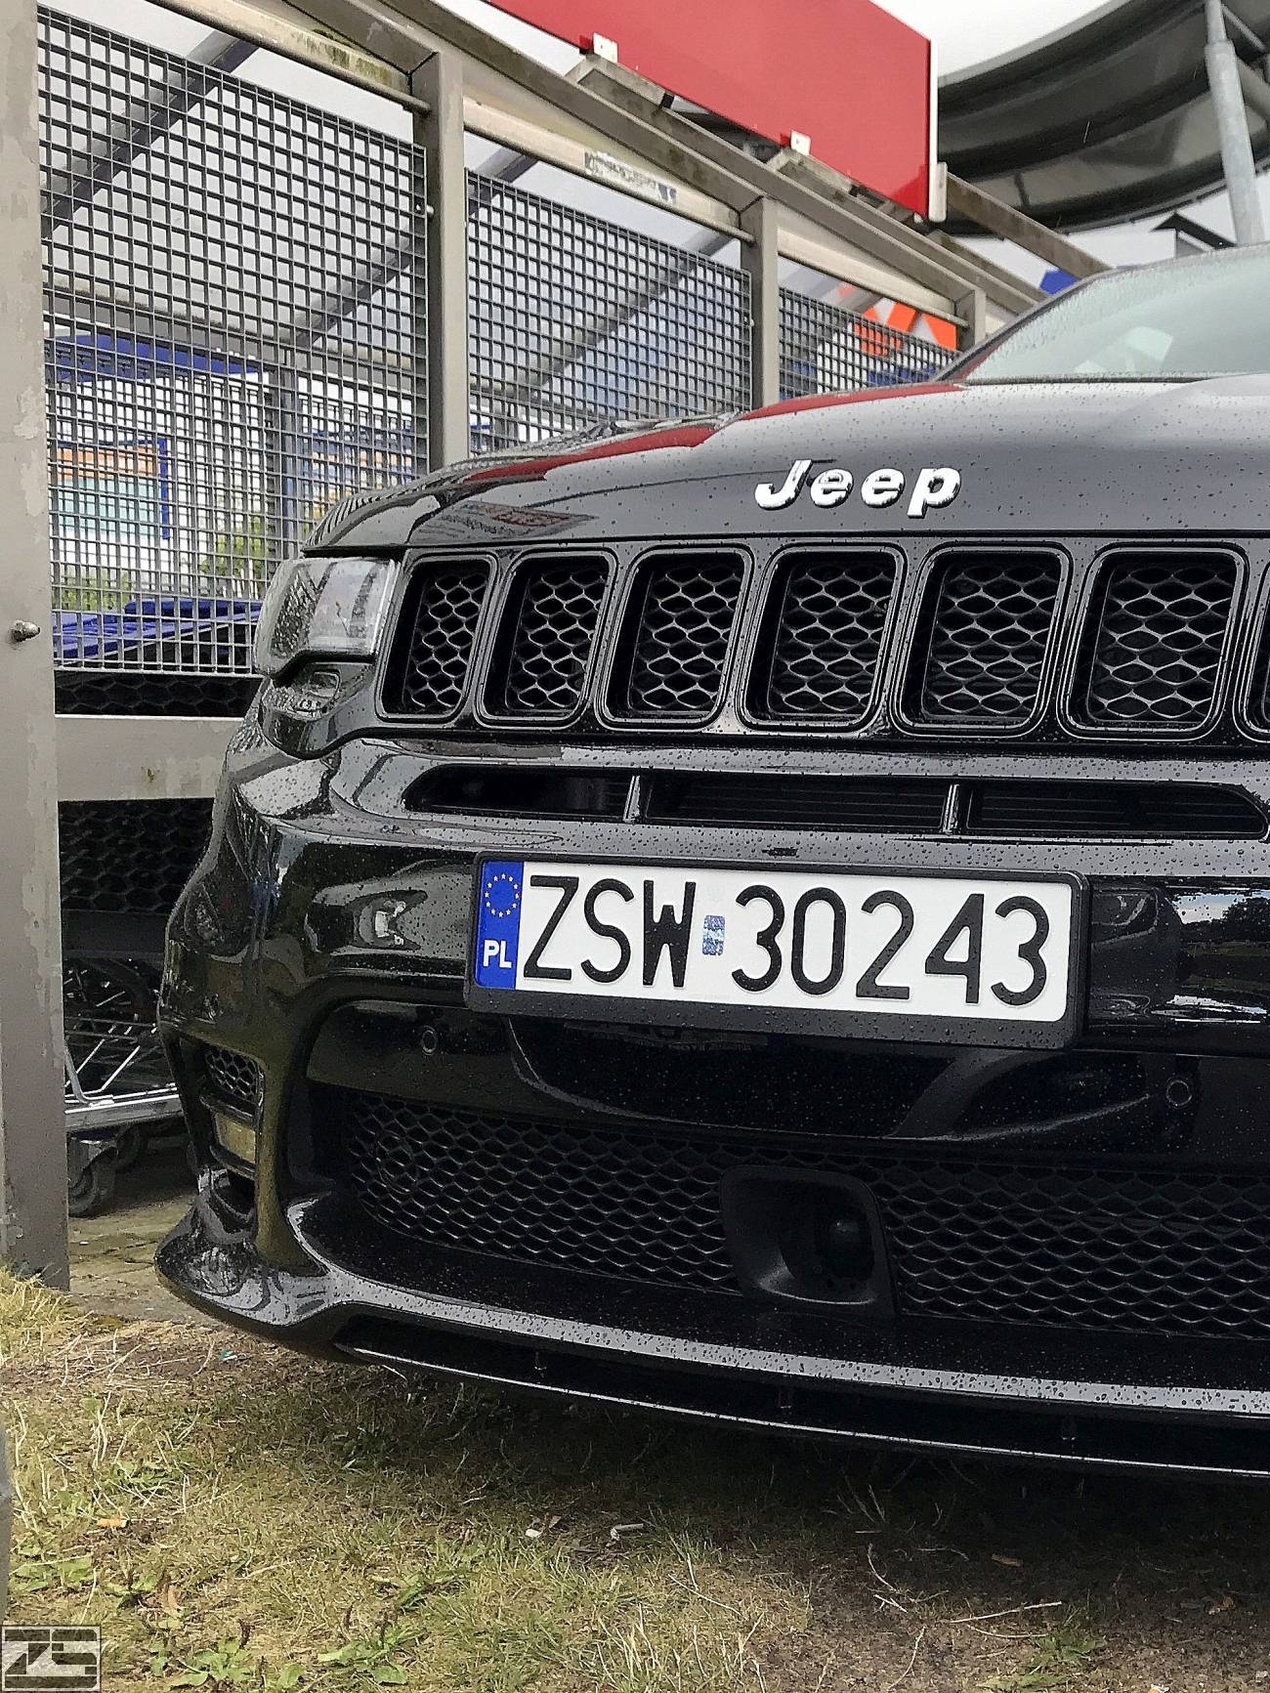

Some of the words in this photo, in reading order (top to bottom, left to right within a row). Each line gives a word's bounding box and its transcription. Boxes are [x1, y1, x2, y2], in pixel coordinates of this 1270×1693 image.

[754, 459, 962, 518] Jeep
[482, 939, 512, 970] PL
[523, 874, 696, 988] ZSW
[731, 884, 1050, 1007] 30243
